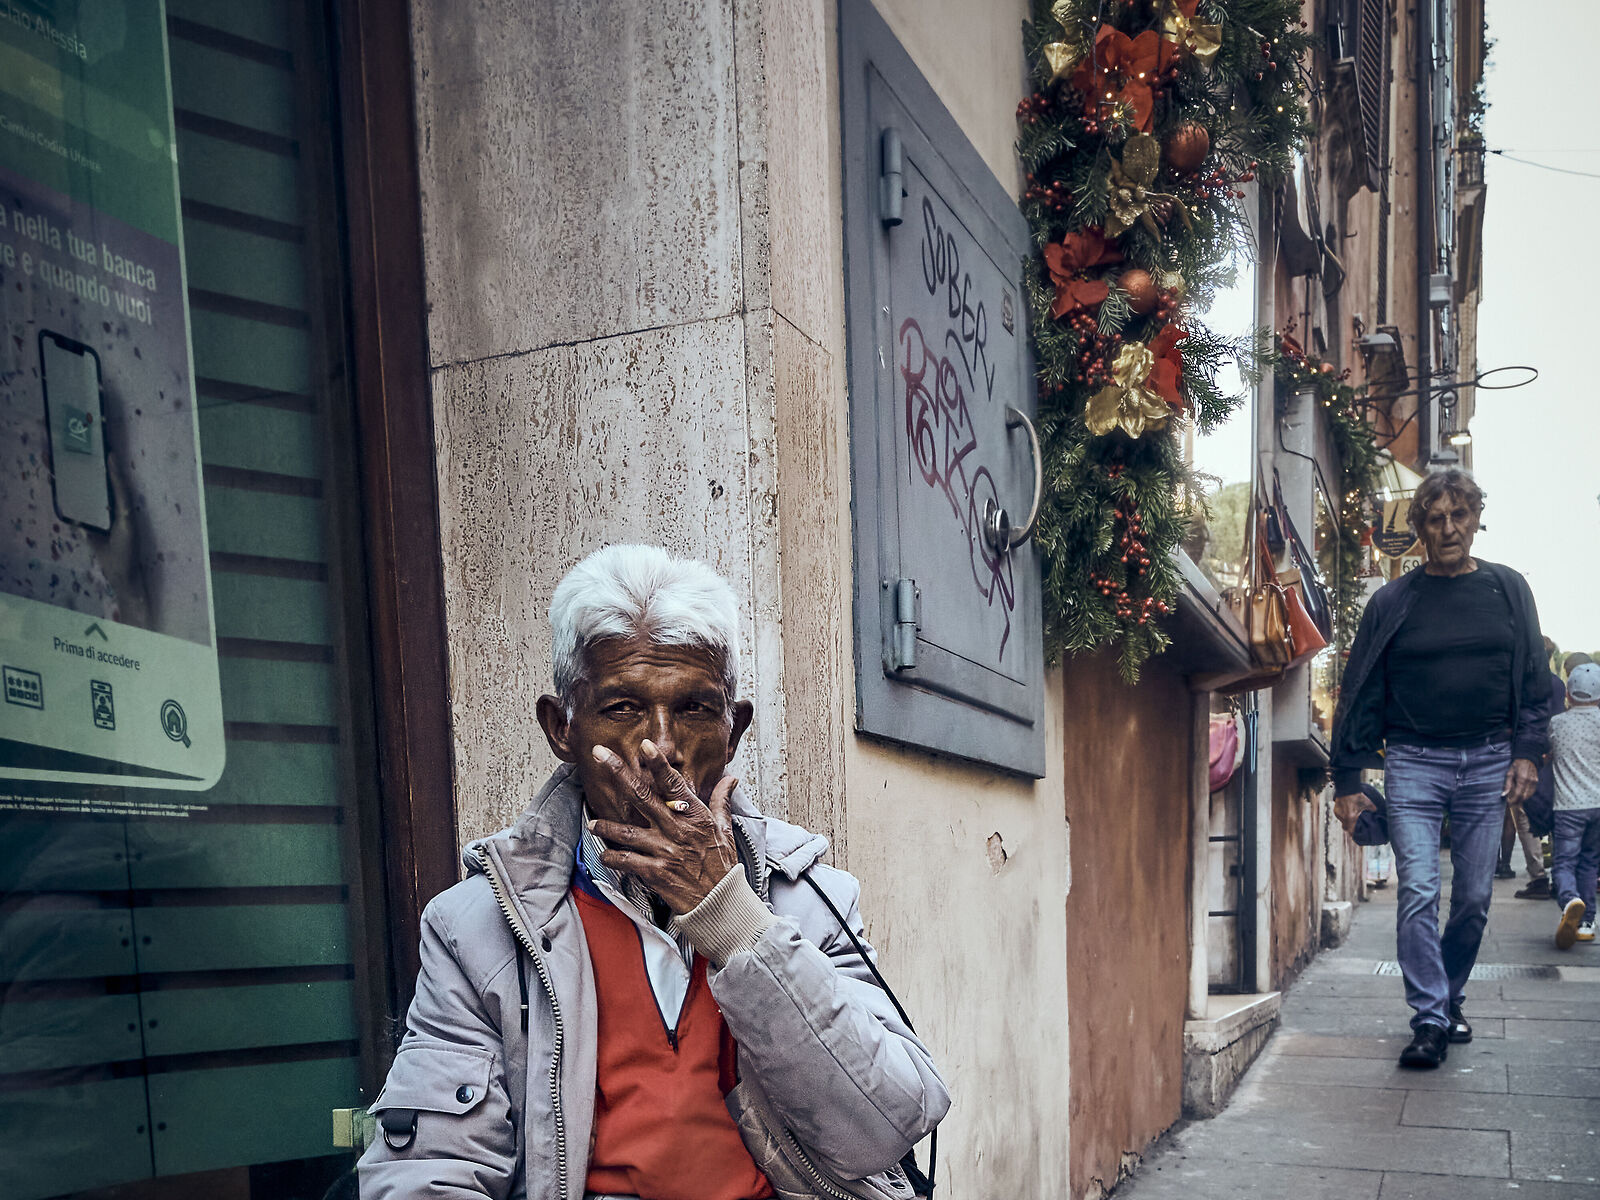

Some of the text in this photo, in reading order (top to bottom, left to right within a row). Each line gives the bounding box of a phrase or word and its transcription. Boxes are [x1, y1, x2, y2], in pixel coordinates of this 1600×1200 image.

[34, 15, 88, 60] Alessia
[13, 210, 62, 250] nella
[66, 229, 98, 266] tua
[102, 243, 156, 291] banca
[21, 251, 33, 276] e
[39, 259, 110, 307] quando
[114, 290, 152, 325] vuoi
[53, 636, 141, 671] Prima di accedere
